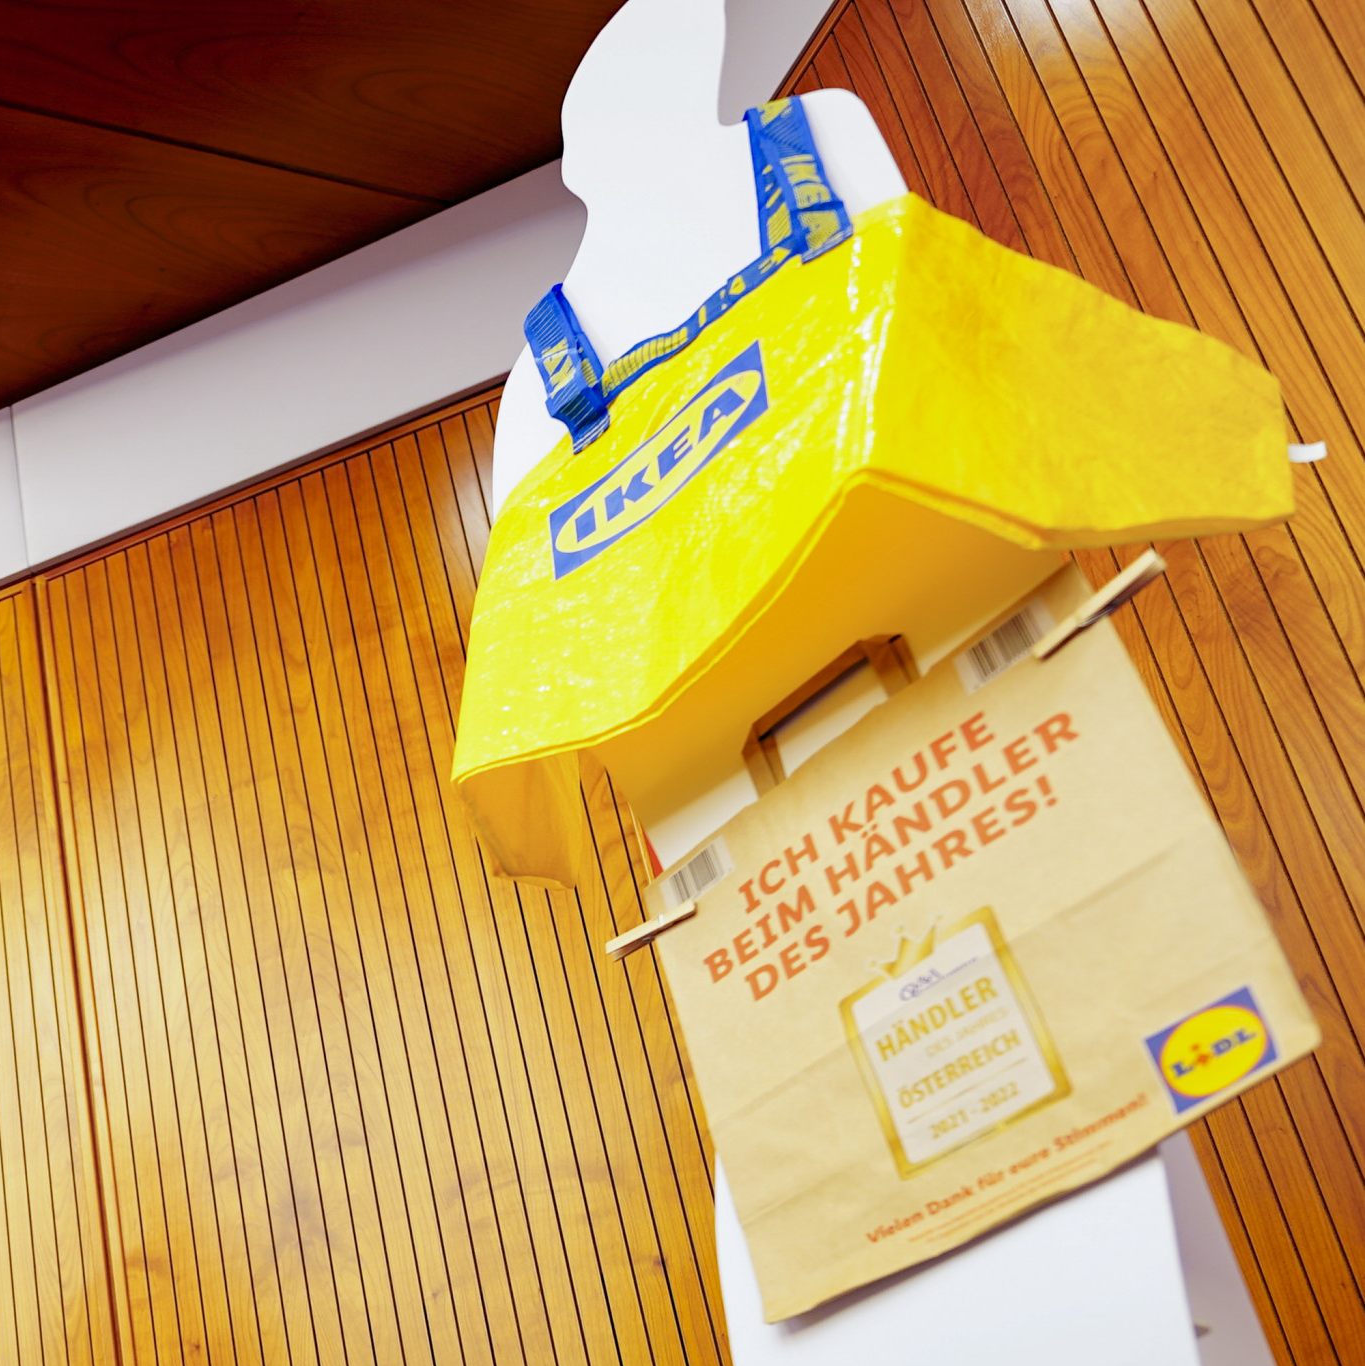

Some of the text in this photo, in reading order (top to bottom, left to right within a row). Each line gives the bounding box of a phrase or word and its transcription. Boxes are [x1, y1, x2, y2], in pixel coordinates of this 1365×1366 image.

[575, 388, 745, 543] IKEA
[702, 711, 1080, 984] BEIM HÄNDLER
[738, 710, 996, 914] ICH KAUFE
[744, 773, 1058, 1002] DES JAHRES!
[875, 976, 999, 1062] HÄNDLER
[897, 1029, 1021, 1109] ÖSTERREICH
